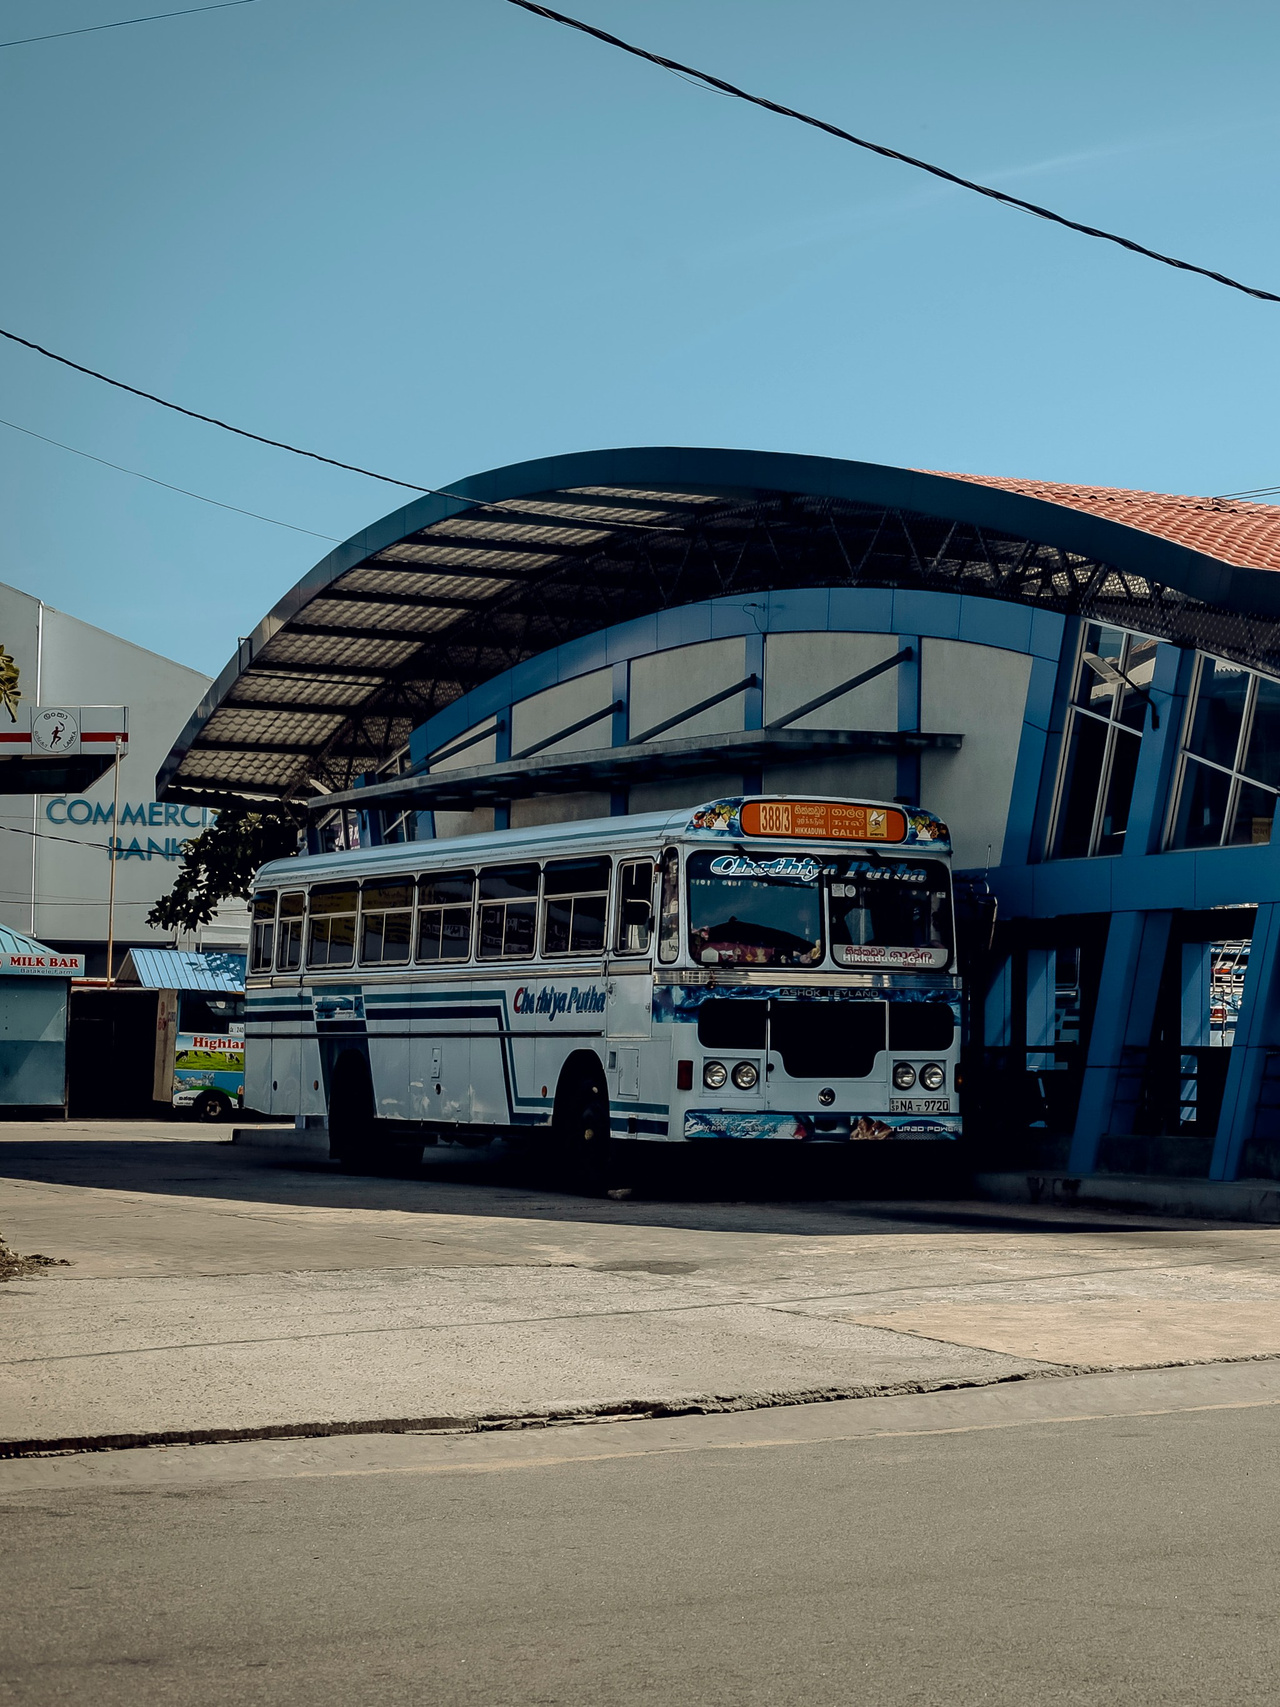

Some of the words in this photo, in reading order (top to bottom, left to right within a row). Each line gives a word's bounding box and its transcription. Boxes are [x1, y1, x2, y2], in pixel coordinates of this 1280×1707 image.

[63, 731, 77, 748] LANKA
[832, 808, 864, 818] ගාල්ල
[762, 806, 790, 832] 388/3
[795, 827, 826, 835] HIKKADUWA
[832, 828, 865, 837] GALLE
[10, 956, 46, 967] MILK
[49, 958, 78, 968] BAR
